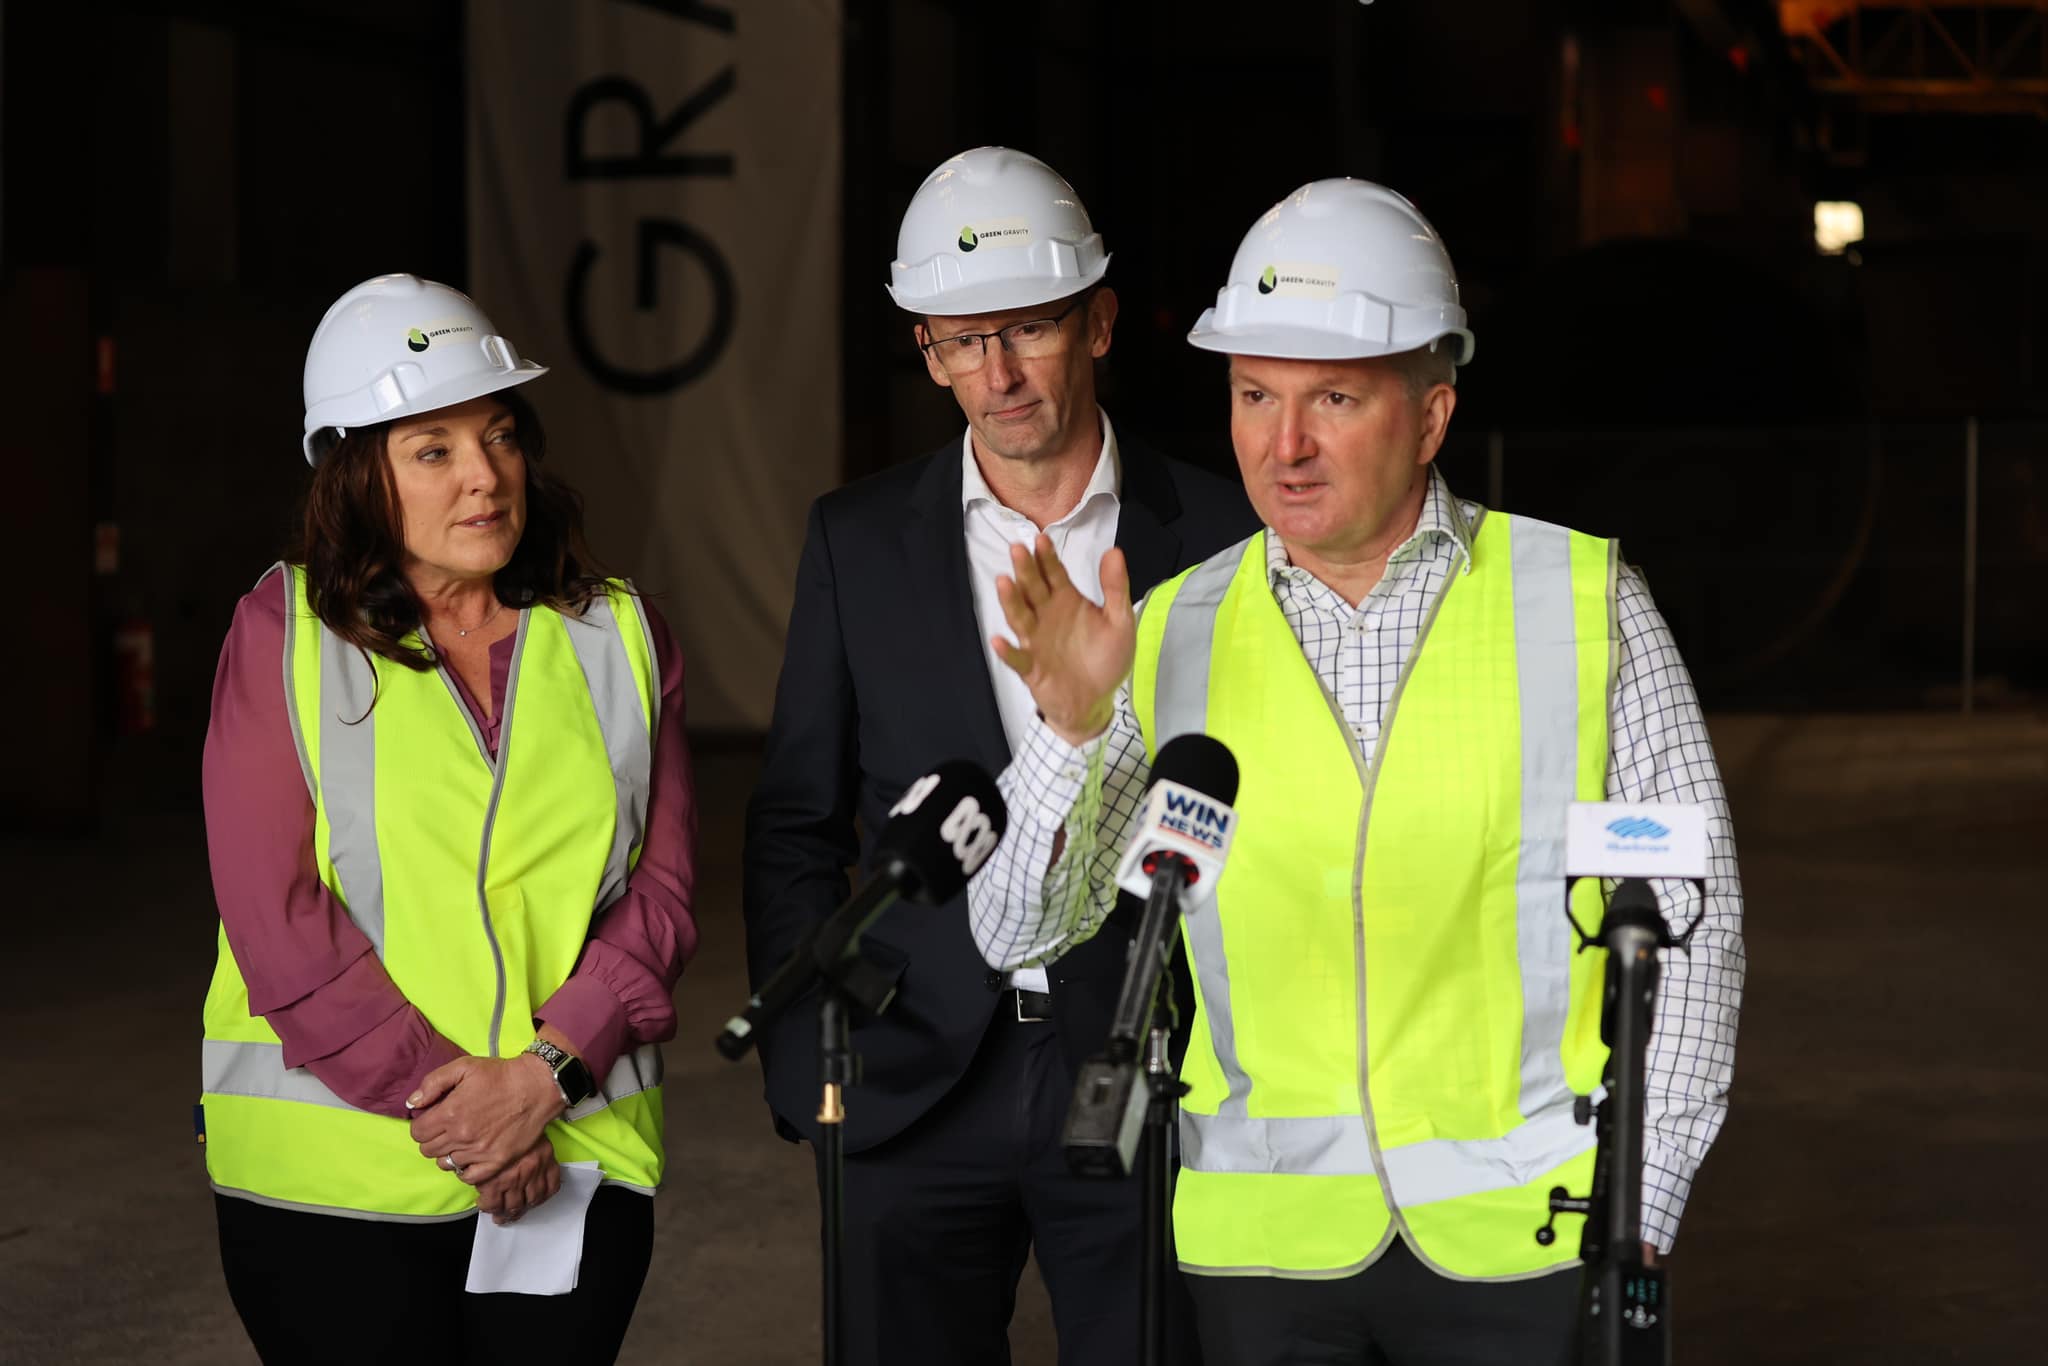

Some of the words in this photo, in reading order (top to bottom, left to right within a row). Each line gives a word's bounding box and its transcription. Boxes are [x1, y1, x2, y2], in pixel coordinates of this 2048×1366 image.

[980, 230, 1002, 239] GREEN
[1003, 228, 1029, 236] GRAVITY
[429, 328, 451, 337] GREEN
[1166, 788, 1229, 833] WIN
[1161, 813, 1222, 848] NEWS
